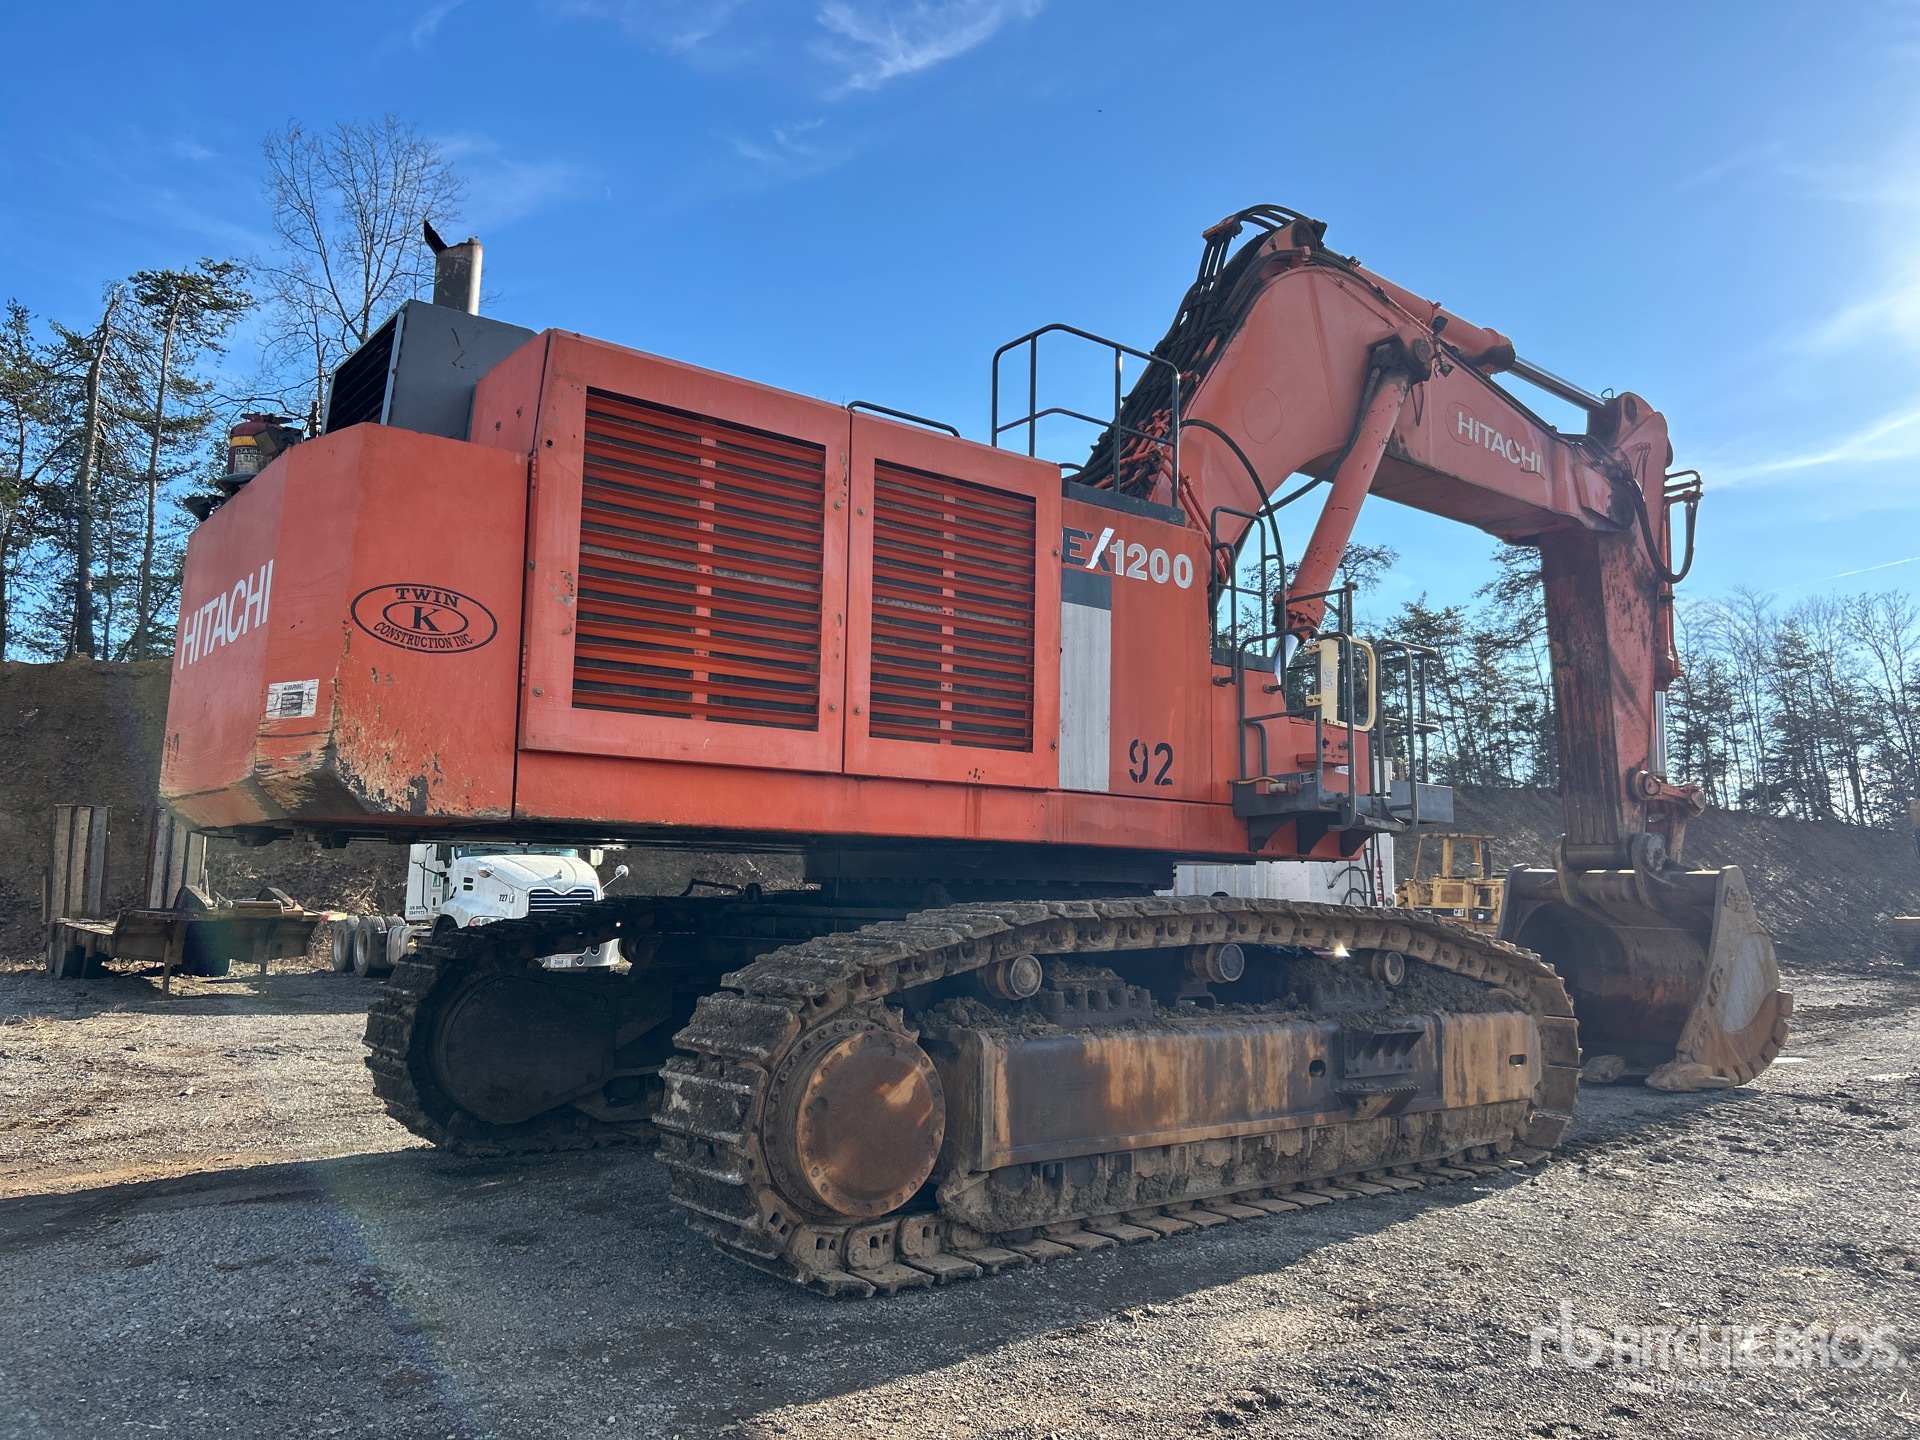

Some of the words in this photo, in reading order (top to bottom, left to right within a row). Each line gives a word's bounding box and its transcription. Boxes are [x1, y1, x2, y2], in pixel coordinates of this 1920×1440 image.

[1457, 411, 1542, 473] HITACHI
[1062, 527, 1193, 589] EX1200
[180, 559, 274, 670] HITACHI
[395, 588, 460, 608] TWIN
[373, 621, 453, 649] CONSTRUCTION
[412, 605, 442, 632] K
[1129, 739, 1173, 785] 92
[1453, 908, 1464, 917] CAT
